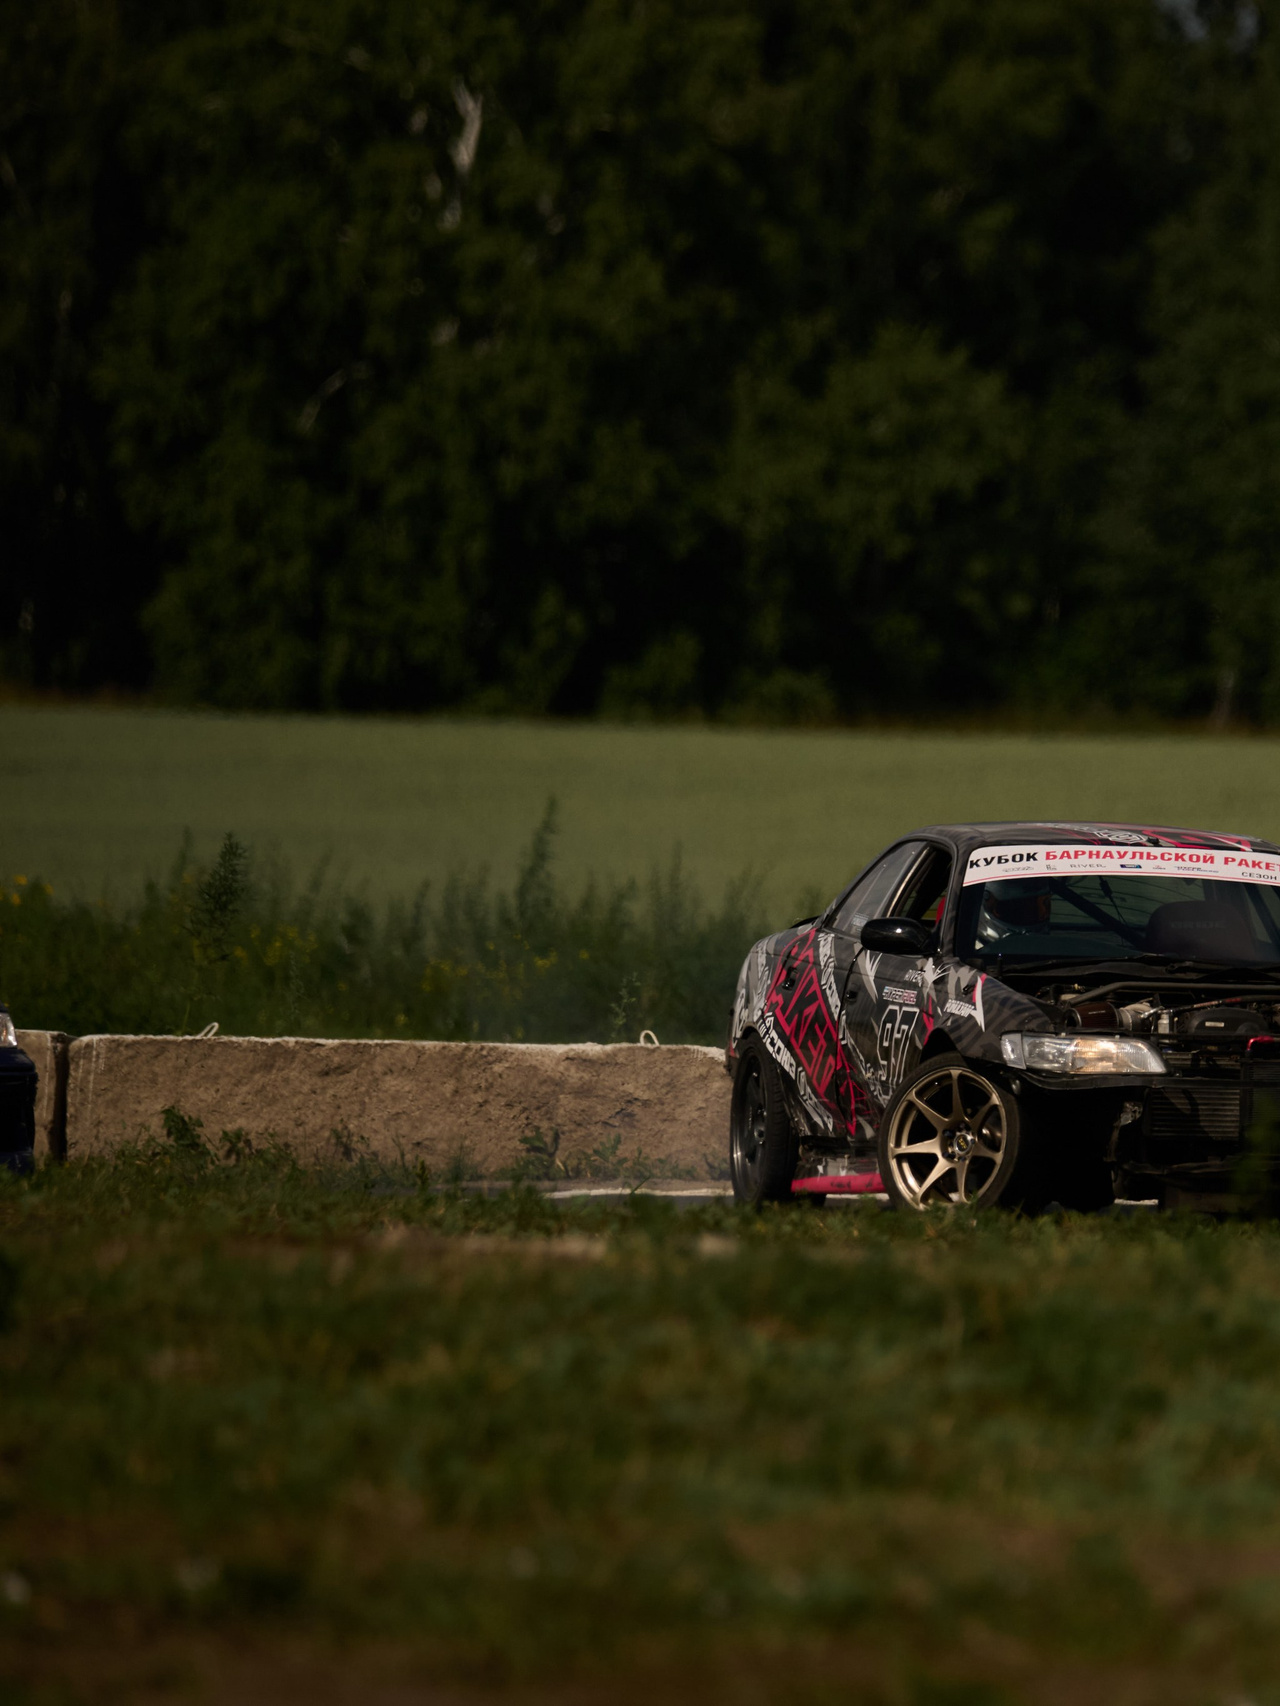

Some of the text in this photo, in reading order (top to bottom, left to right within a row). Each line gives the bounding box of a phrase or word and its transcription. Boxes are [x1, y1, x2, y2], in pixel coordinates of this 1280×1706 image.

[969, 851, 1039, 869] КУБОК
[1045, 850, 1215, 865] БАРНАУЛЬСКОЙ
[1241, 871, 1278, 881] СЕЗОН
